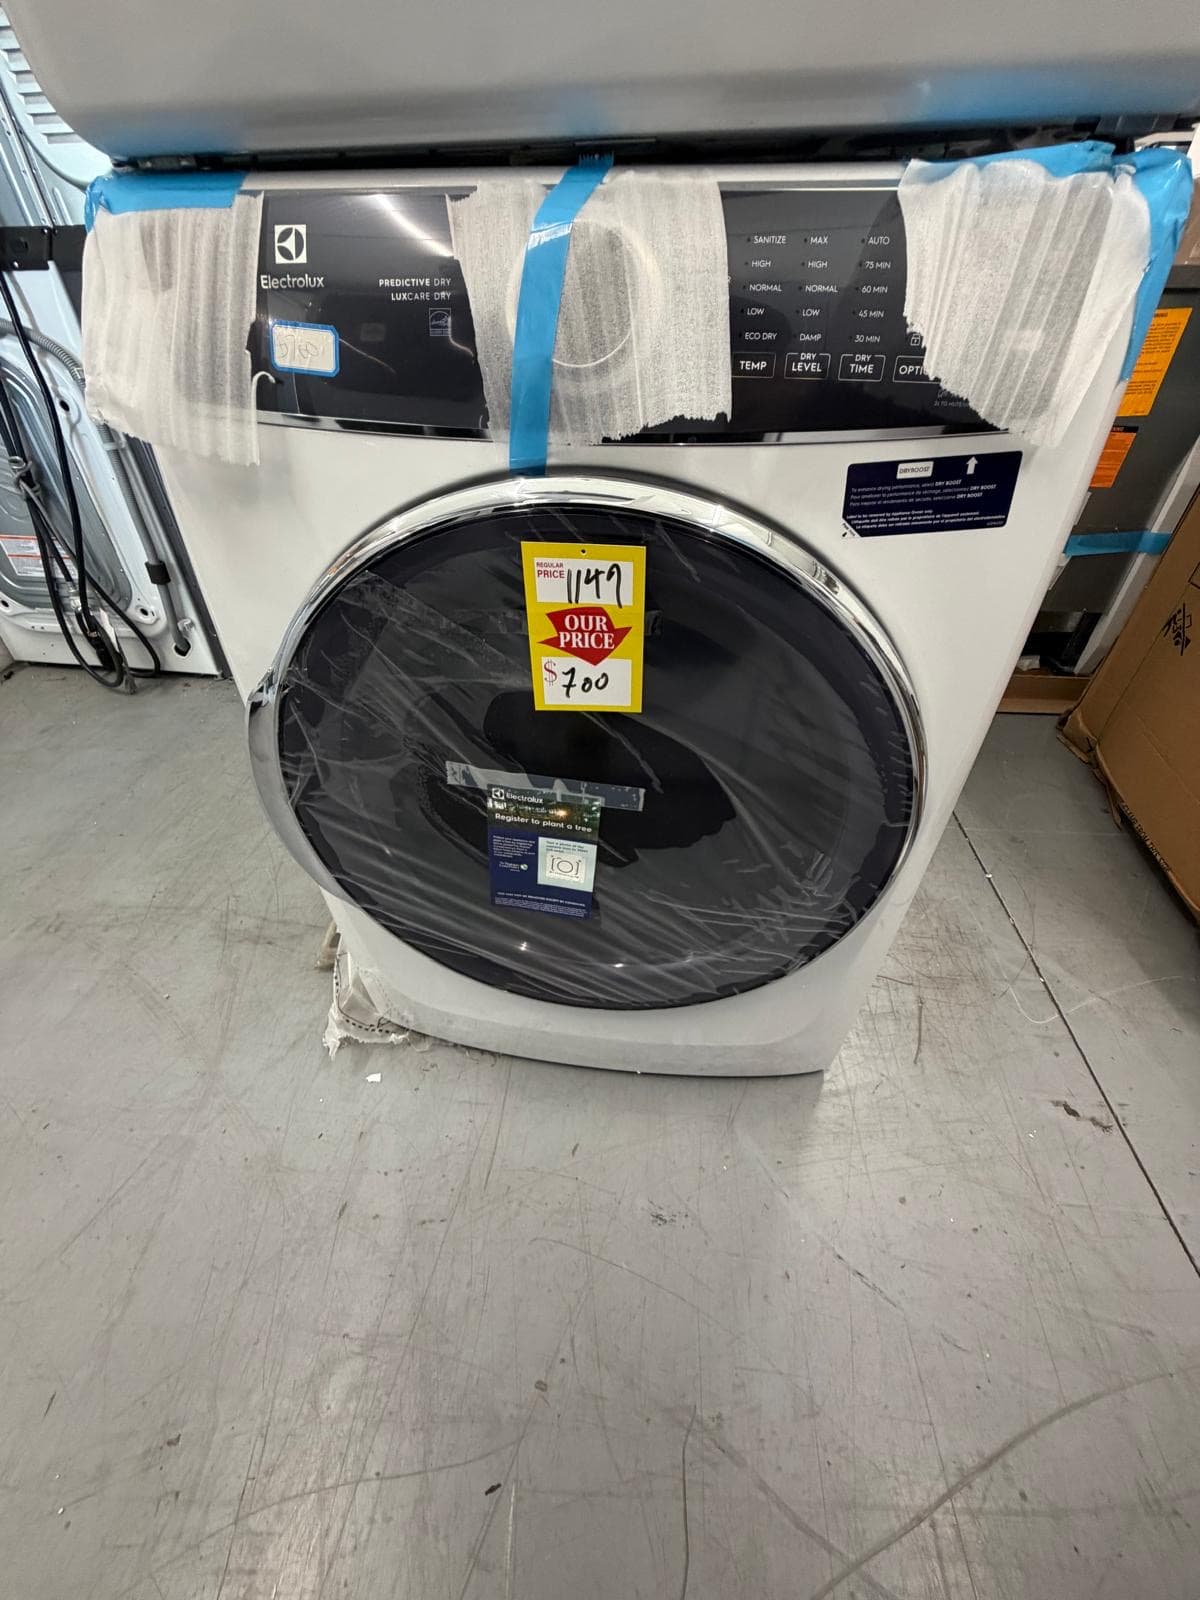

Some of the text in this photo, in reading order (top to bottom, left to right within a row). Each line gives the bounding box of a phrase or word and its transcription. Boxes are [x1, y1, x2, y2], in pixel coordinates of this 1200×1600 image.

[753, 235, 787, 244] SANITIZE
[810, 236, 829, 244] MAX
[867, 236, 890, 245] AUTO
[751, 260, 771, 268] HIGH
[807, 260, 828, 268] HIGH
[865, 261, 891, 269] 75 MIN
[260, 273, 325, 289] Electrolux
[378, 278, 451, 287] PREDICTIVE DRY
[749, 284, 782, 292] NORMAL
[805, 285, 838, 293] NORMAL
[861, 285, 888, 294] 60 MIN
[391, 291, 451, 301] LUXCARE DRY
[747, 307, 765, 315] LOW
[802, 308, 821, 316] LOW
[858, 310, 885, 318] 45 MIN
[744, 332, 778, 340] ECO DRY
[800, 333, 822, 341] DAMP
[855, 334, 881, 343] 30 MIN
[801, 352, 817, 360] DRY
[855, 354, 872, 362] DRY
[740, 360, 767, 371] TEMP
[792, 361, 822, 372] LEVEL
[849, 363, 873, 374] TIME
[537, 570, 565, 579] PRICE
[566, 563, 623, 609] 1149
[564, 614, 608, 632] OUR
[558, 632, 615, 649] PRICE
[506, 792, 543, 804] Electrolux
[495, 813, 528, 823] Register
[542, 820, 564, 829] plant
[575, 824, 592, 833] tree
